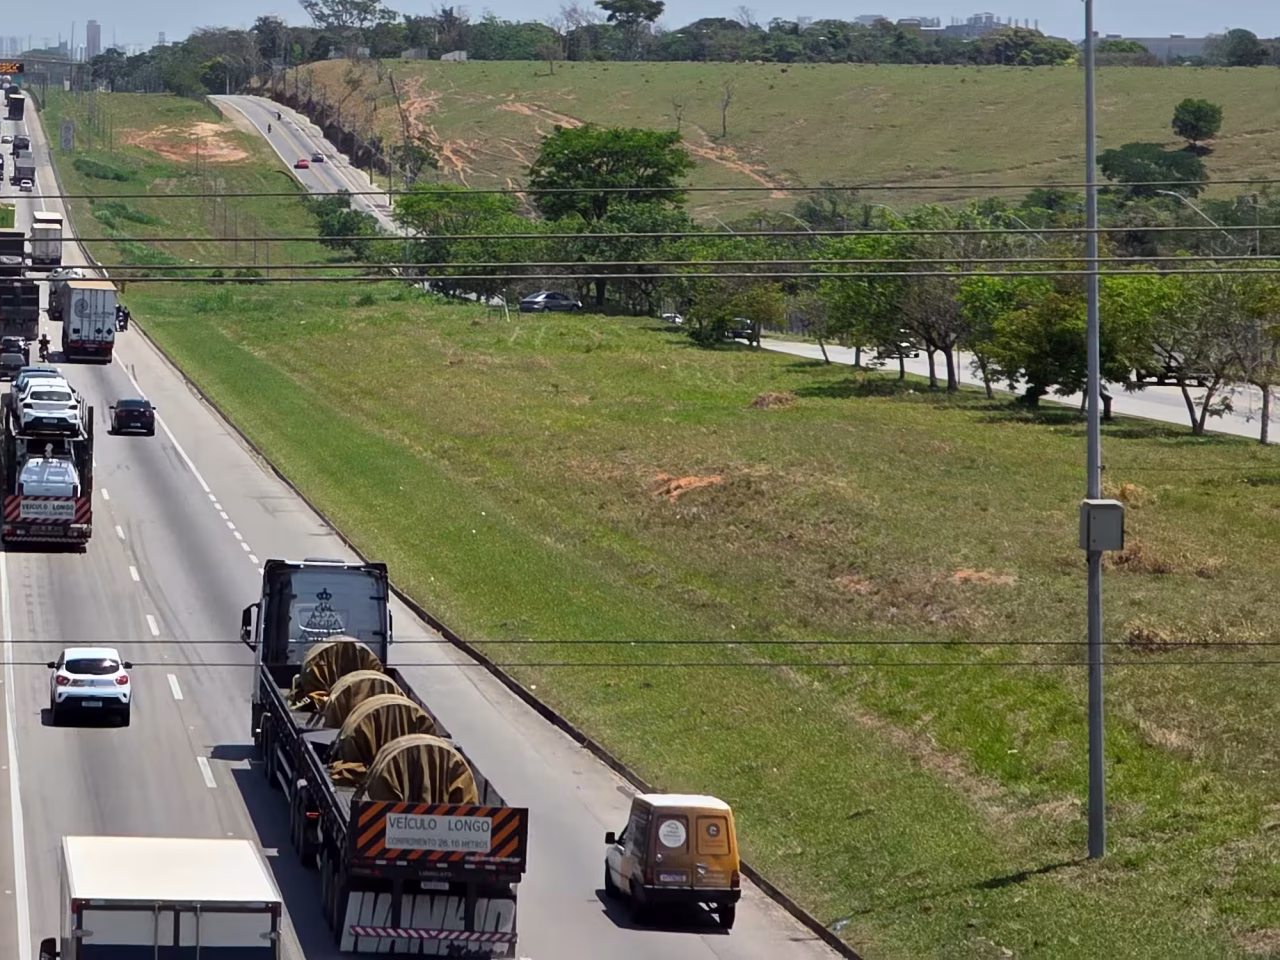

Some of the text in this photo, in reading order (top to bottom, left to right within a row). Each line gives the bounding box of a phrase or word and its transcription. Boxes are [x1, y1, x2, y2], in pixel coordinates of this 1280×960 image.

[388, 815, 490, 833] VEÍCULO LONGO
[461, 840, 488, 849] METROS
